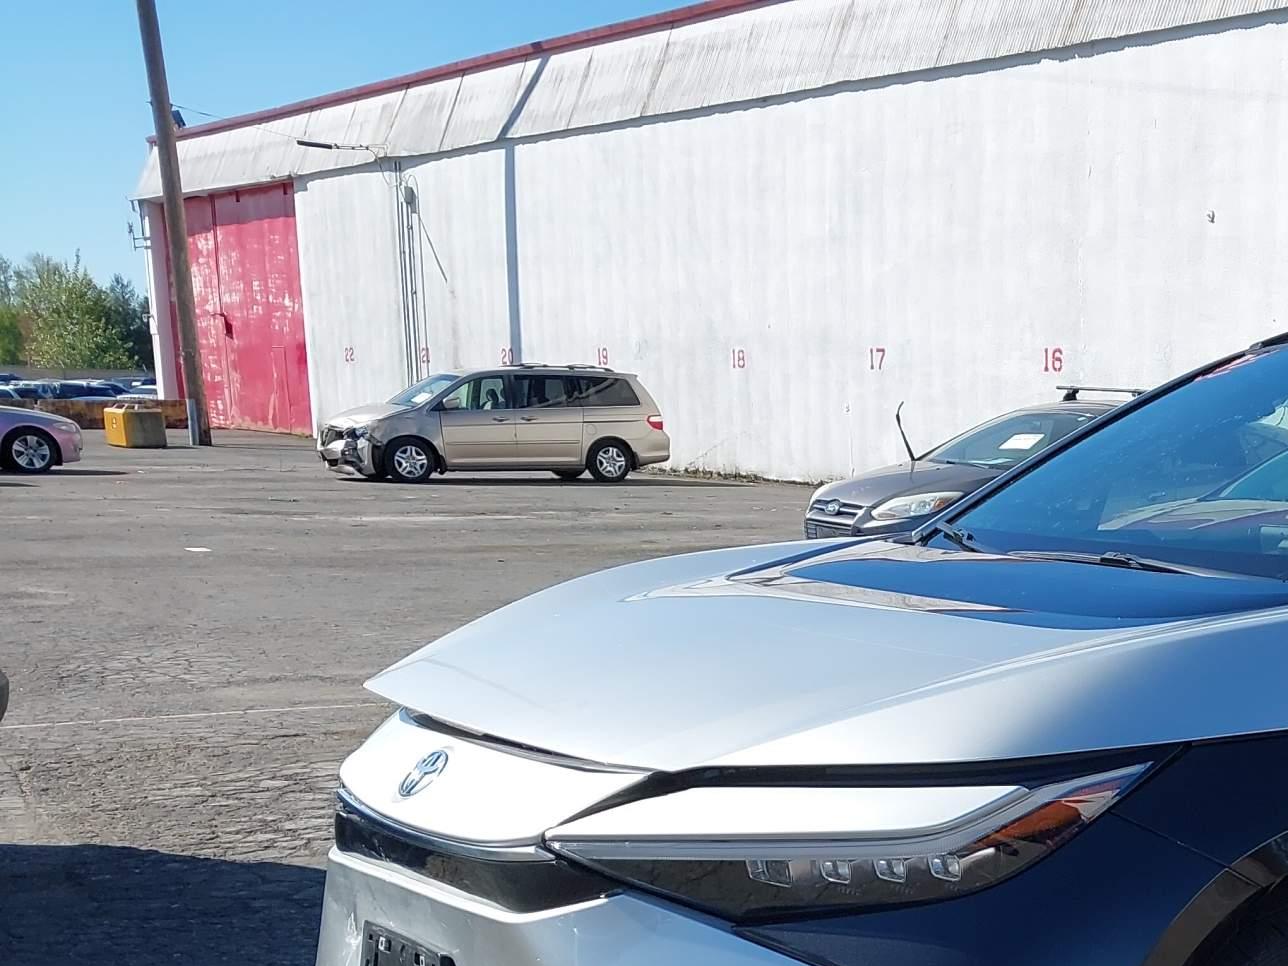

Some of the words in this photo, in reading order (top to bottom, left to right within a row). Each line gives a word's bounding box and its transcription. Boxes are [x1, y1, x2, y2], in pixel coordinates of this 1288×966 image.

[344, 347, 355, 362] 22
[500, 347, 514, 365] 20
[597, 347, 608, 366] 19
[732, 348, 746, 369] 18
[870, 347, 886, 370] 17
[1044, 347, 1063, 373] 16
